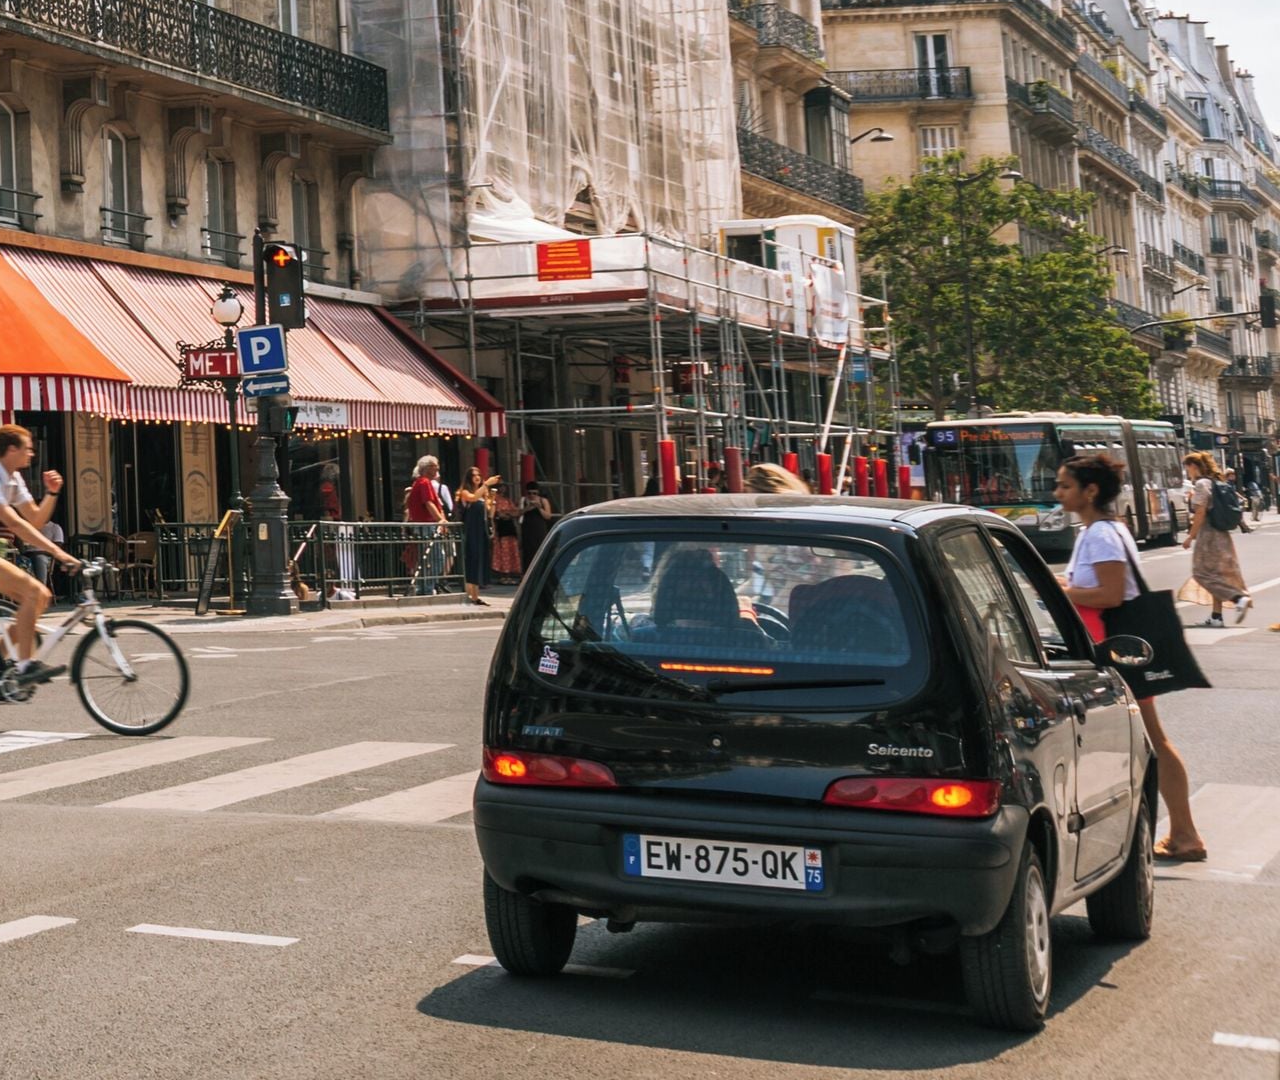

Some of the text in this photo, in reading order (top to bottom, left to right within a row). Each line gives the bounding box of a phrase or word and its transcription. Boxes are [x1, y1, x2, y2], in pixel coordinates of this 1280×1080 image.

[250, 336, 271, 365] P
[190, 352, 240, 376] MET
[937, 431, 954, 442] 95
[523, 726, 562, 736] FIAT
[867, 743, 934, 758] Seicento
[629, 856, 636, 865] F
[646, 840, 799, 881] EW-875-QK
[807, 870, 821, 883] 75
